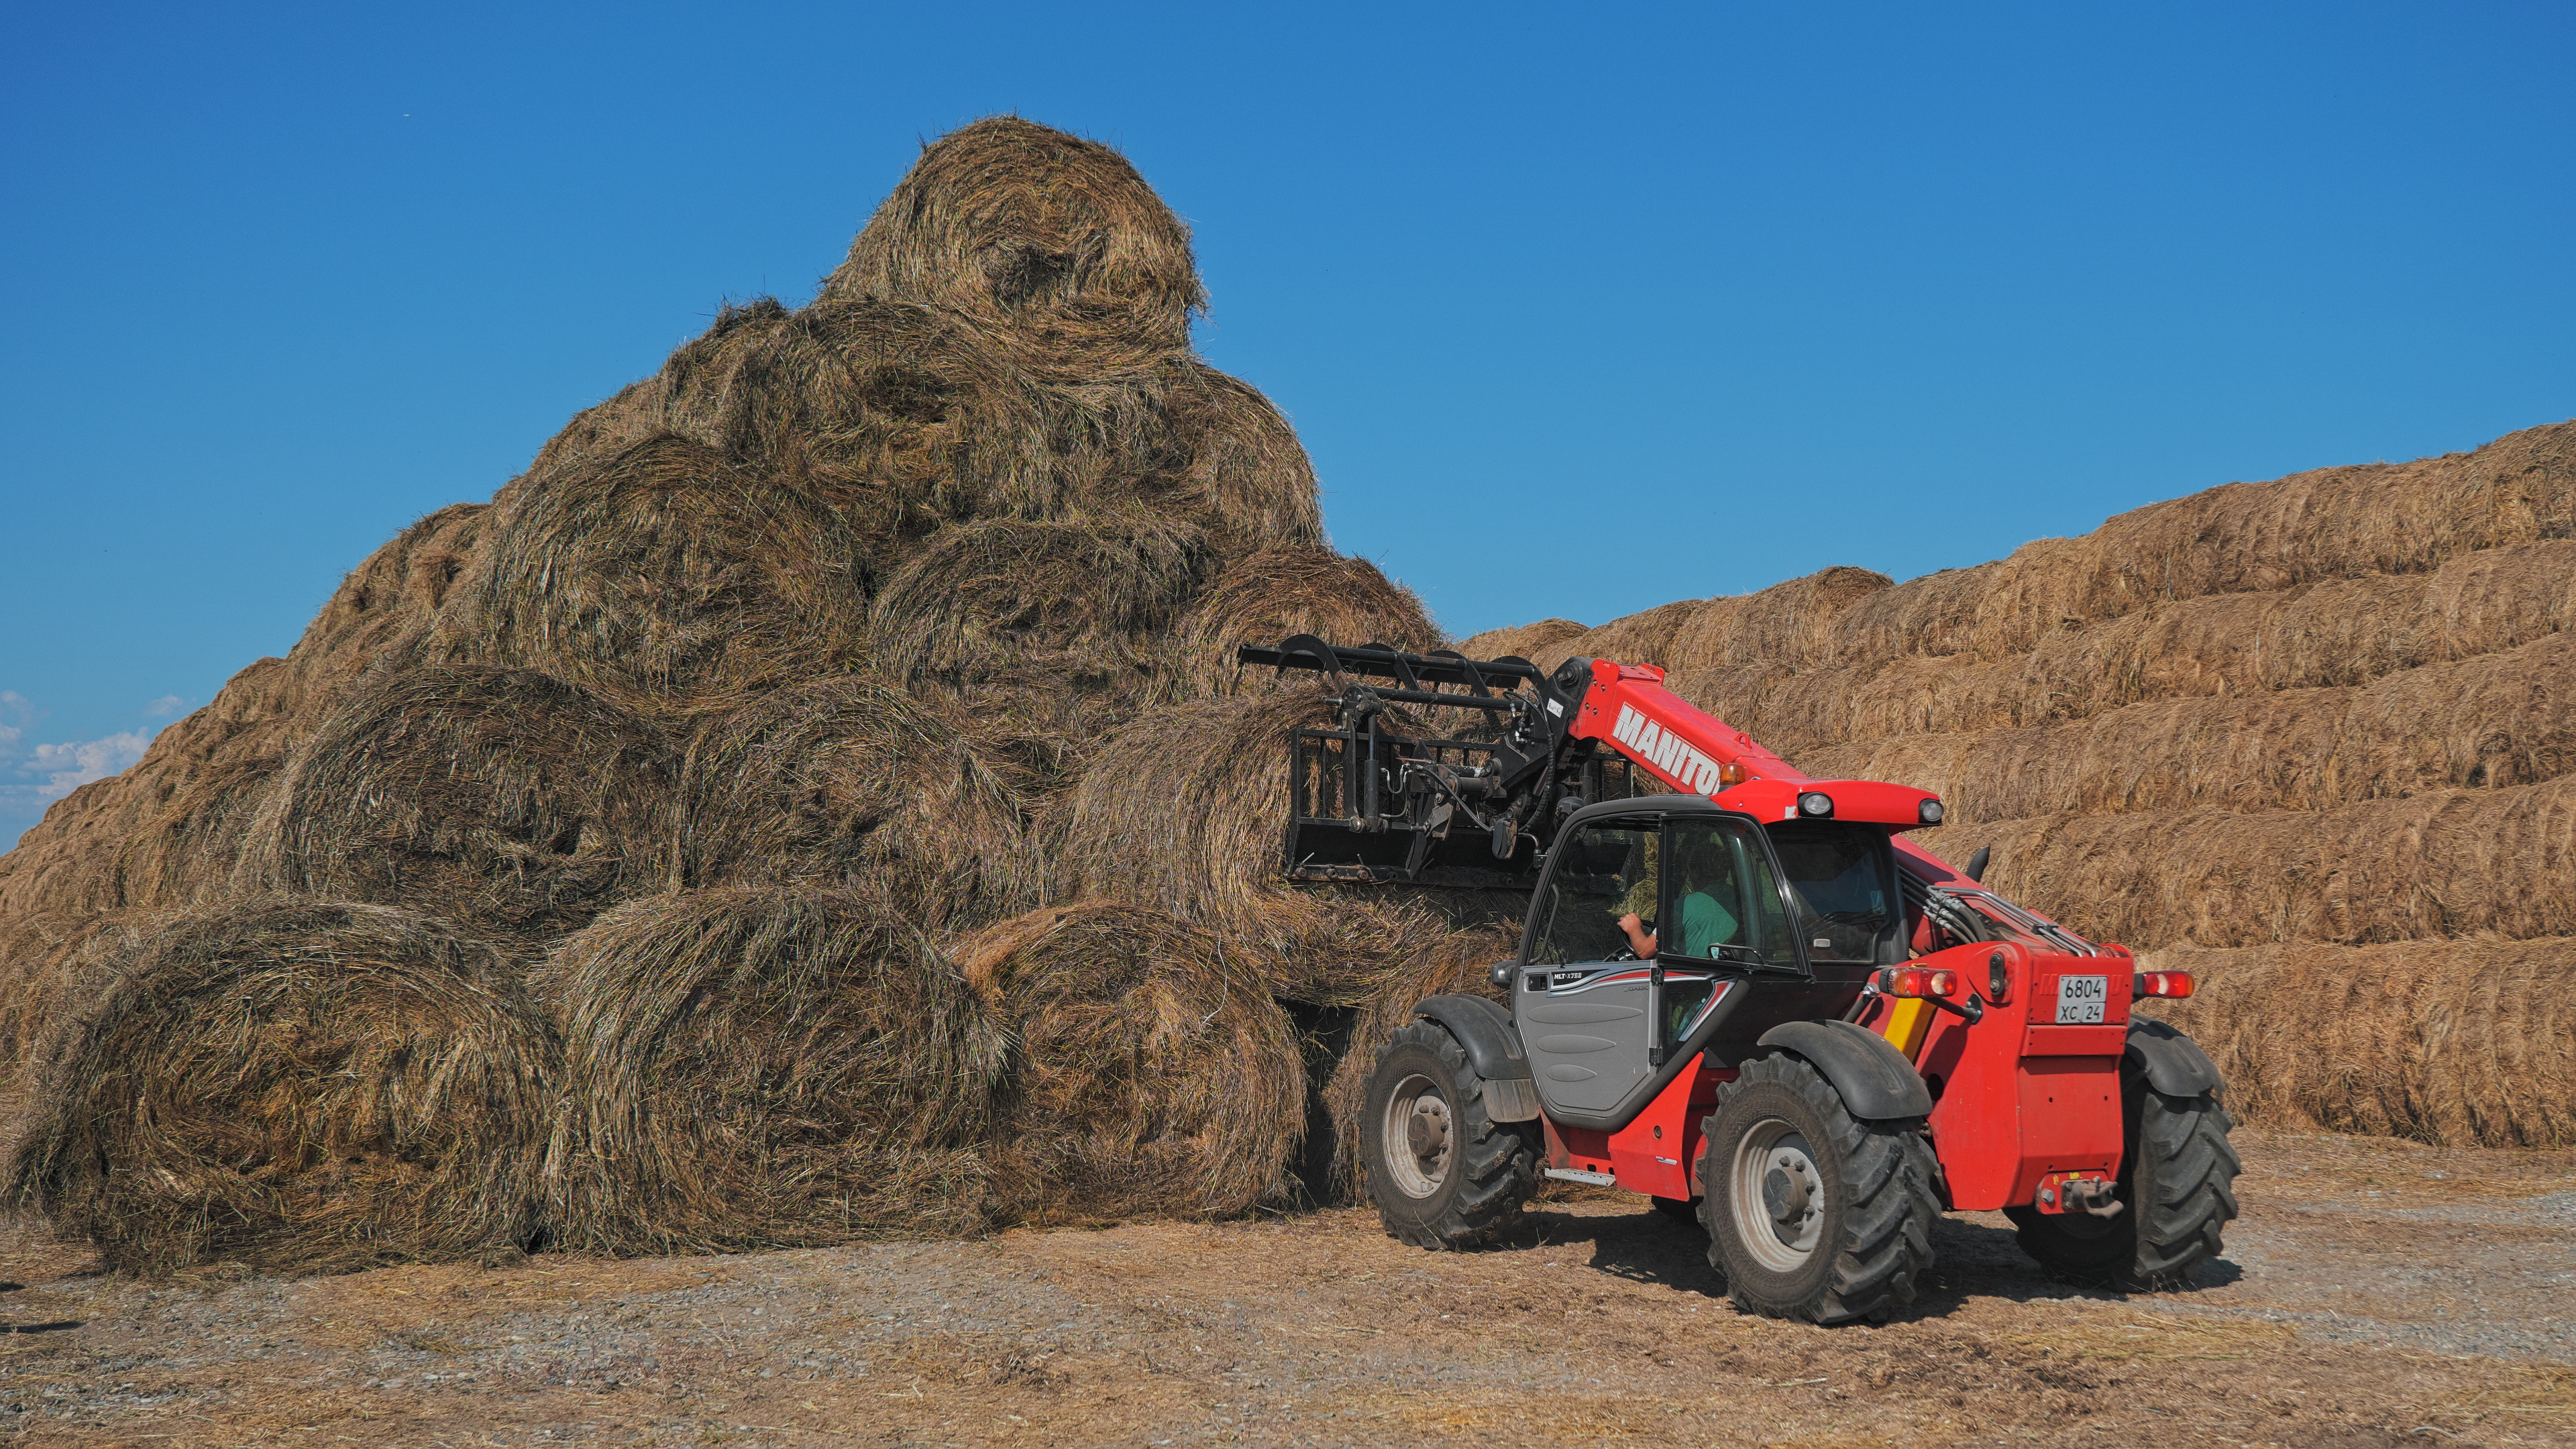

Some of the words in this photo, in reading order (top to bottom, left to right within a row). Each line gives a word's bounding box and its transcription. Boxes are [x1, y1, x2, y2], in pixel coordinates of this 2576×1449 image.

[1612, 702, 1721, 796] MANITO
[2065, 979, 2101, 998] 6804
[2085, 1006, 2100, 1020] 24
